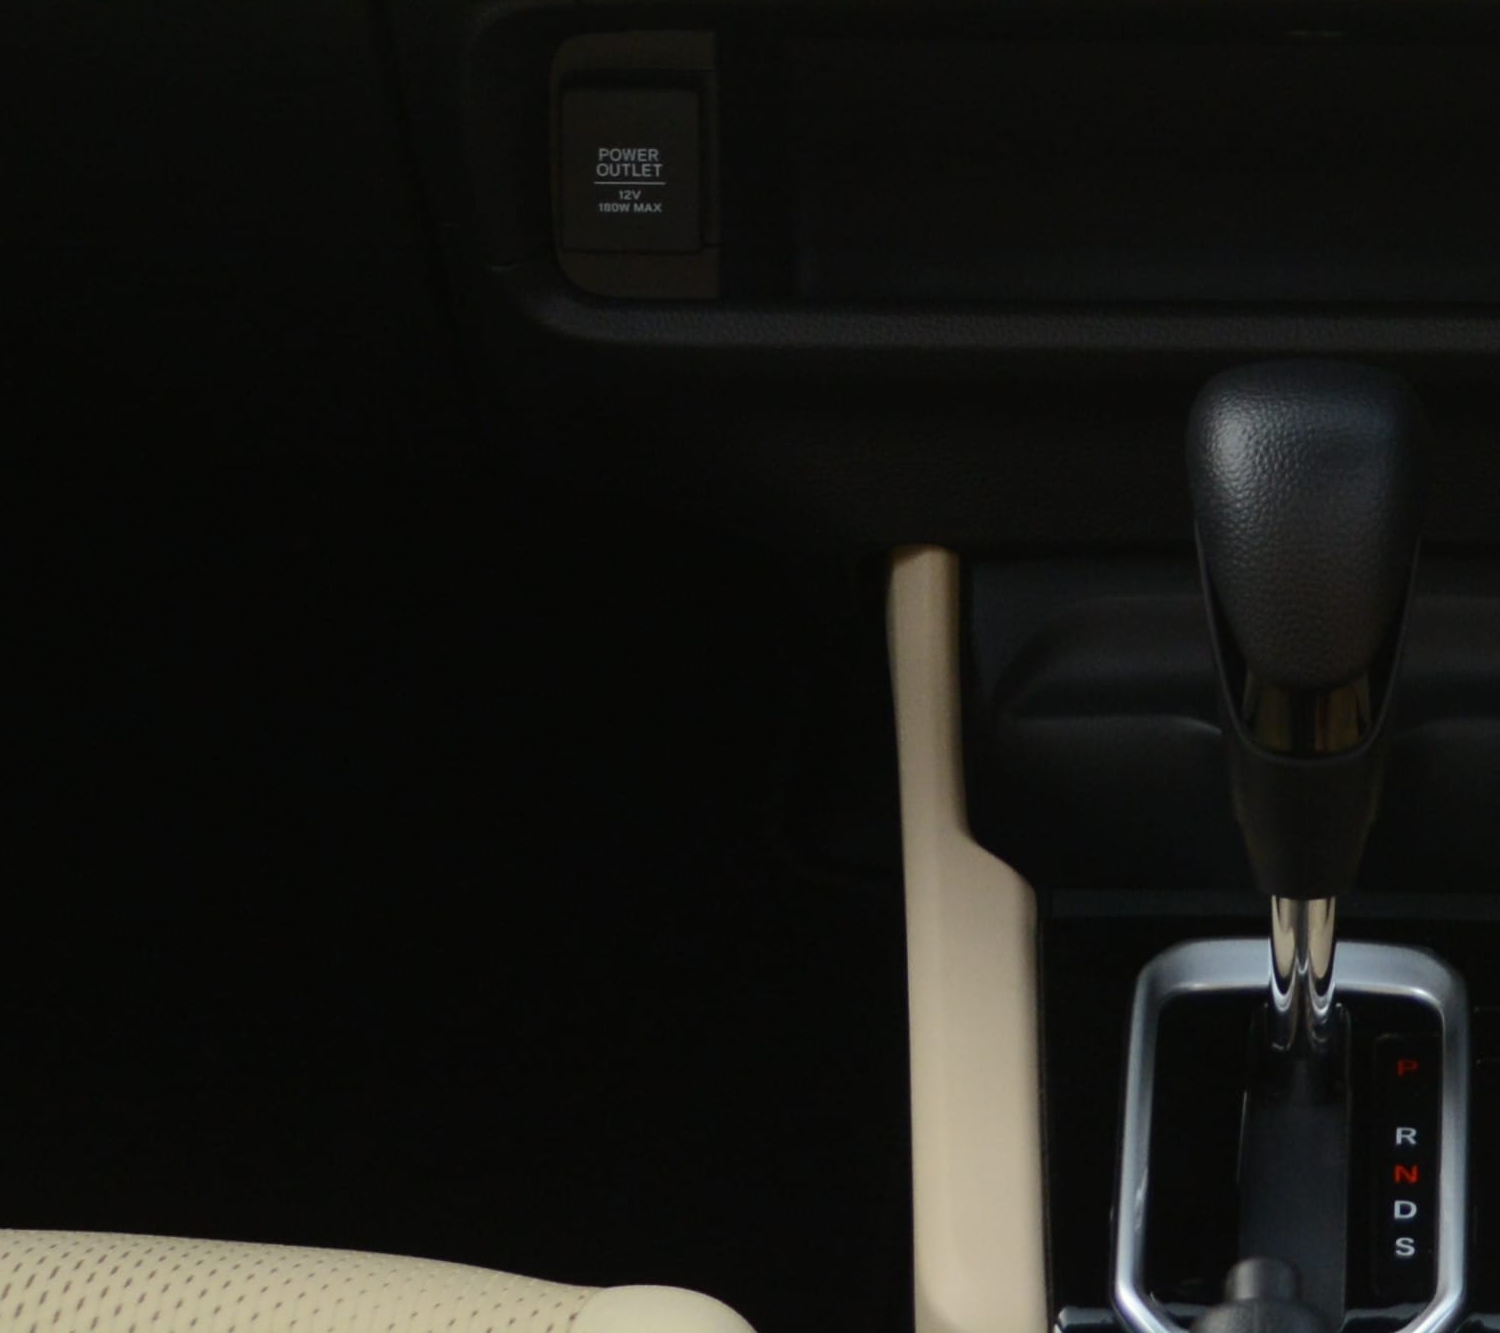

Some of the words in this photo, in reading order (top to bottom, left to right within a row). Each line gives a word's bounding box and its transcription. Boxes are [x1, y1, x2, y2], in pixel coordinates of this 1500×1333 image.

[598, 148, 659, 162] POWER
[596, 163, 663, 177] OUTLET
[618, 190, 642, 200] 12V
[634, 203, 662, 213] MAX
[1396, 1060, 1418, 1076] P
[1395, 1127, 1417, 1145] R
[1393, 1165, 1419, 1184] N
[1393, 1200, 1417, 1219] D
[1395, 1237, 1416, 1256] S
